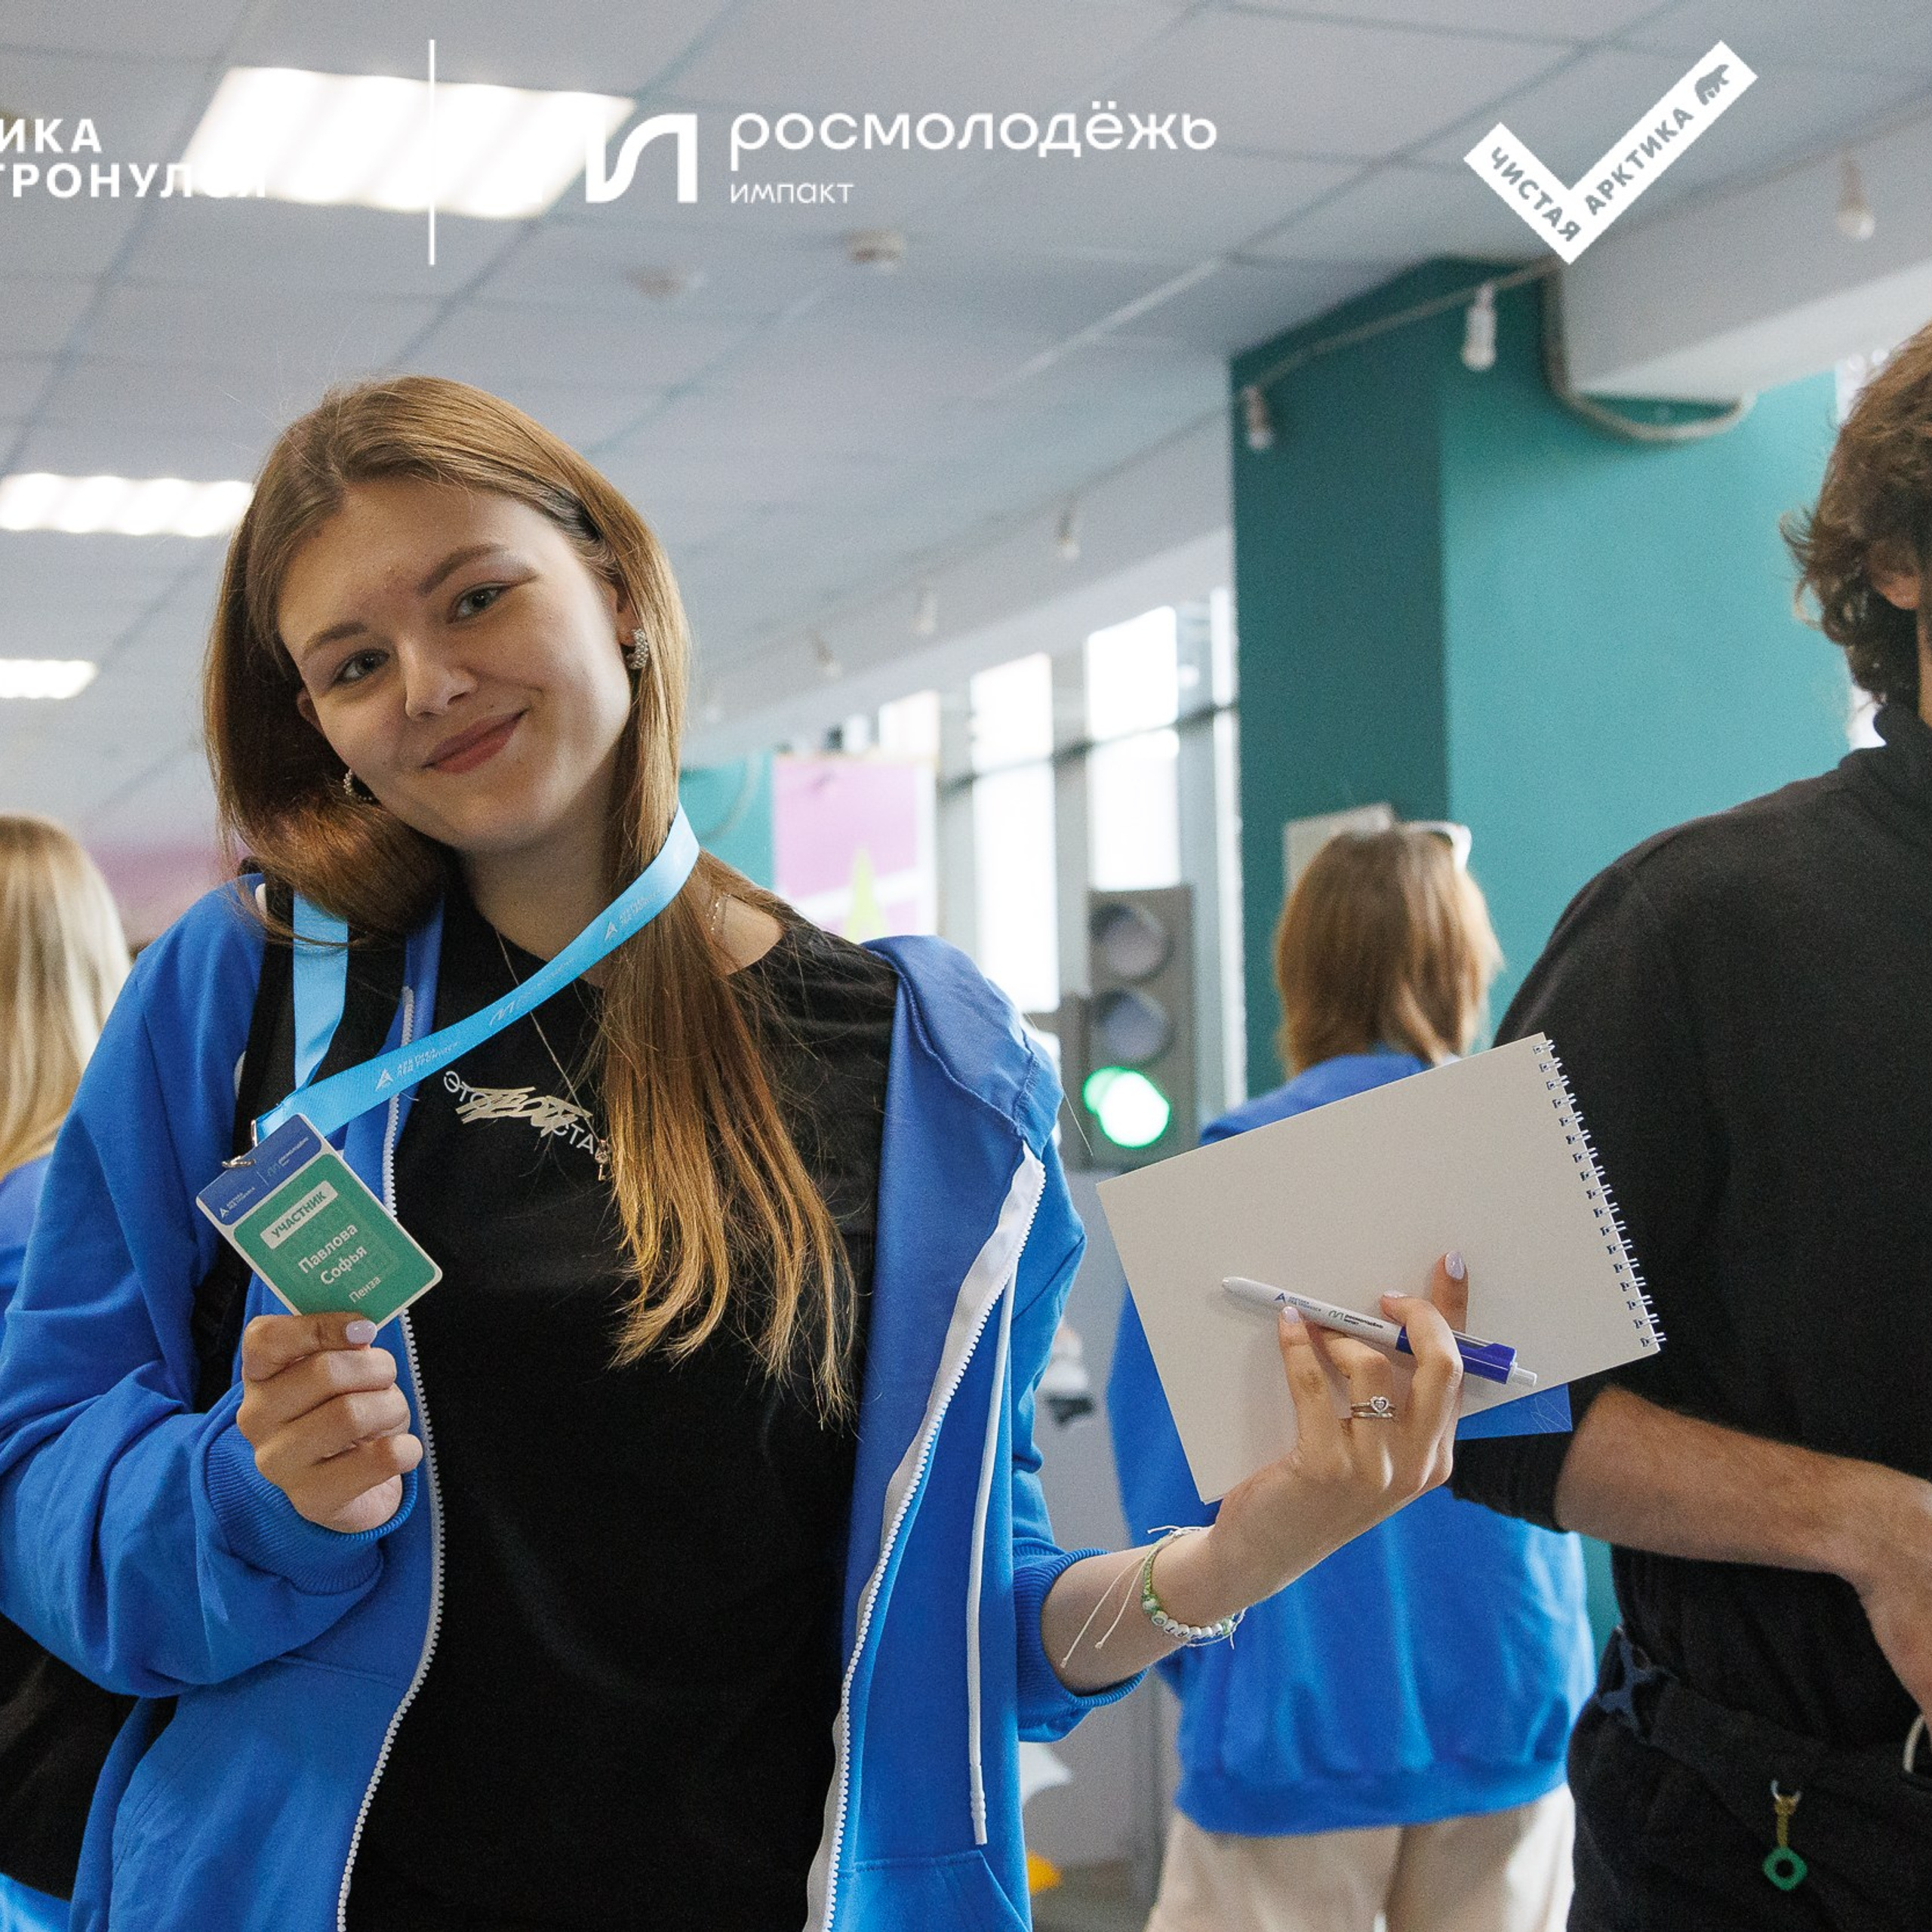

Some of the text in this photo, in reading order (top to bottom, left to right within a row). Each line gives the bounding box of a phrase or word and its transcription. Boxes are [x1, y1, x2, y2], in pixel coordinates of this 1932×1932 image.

[271, 1191, 327, 1238] УЧАСТНИК
[297, 1223, 358, 1274] Павлова
[320, 1245, 368, 1285] Софья
[349, 1275, 382, 1304] Пенза
